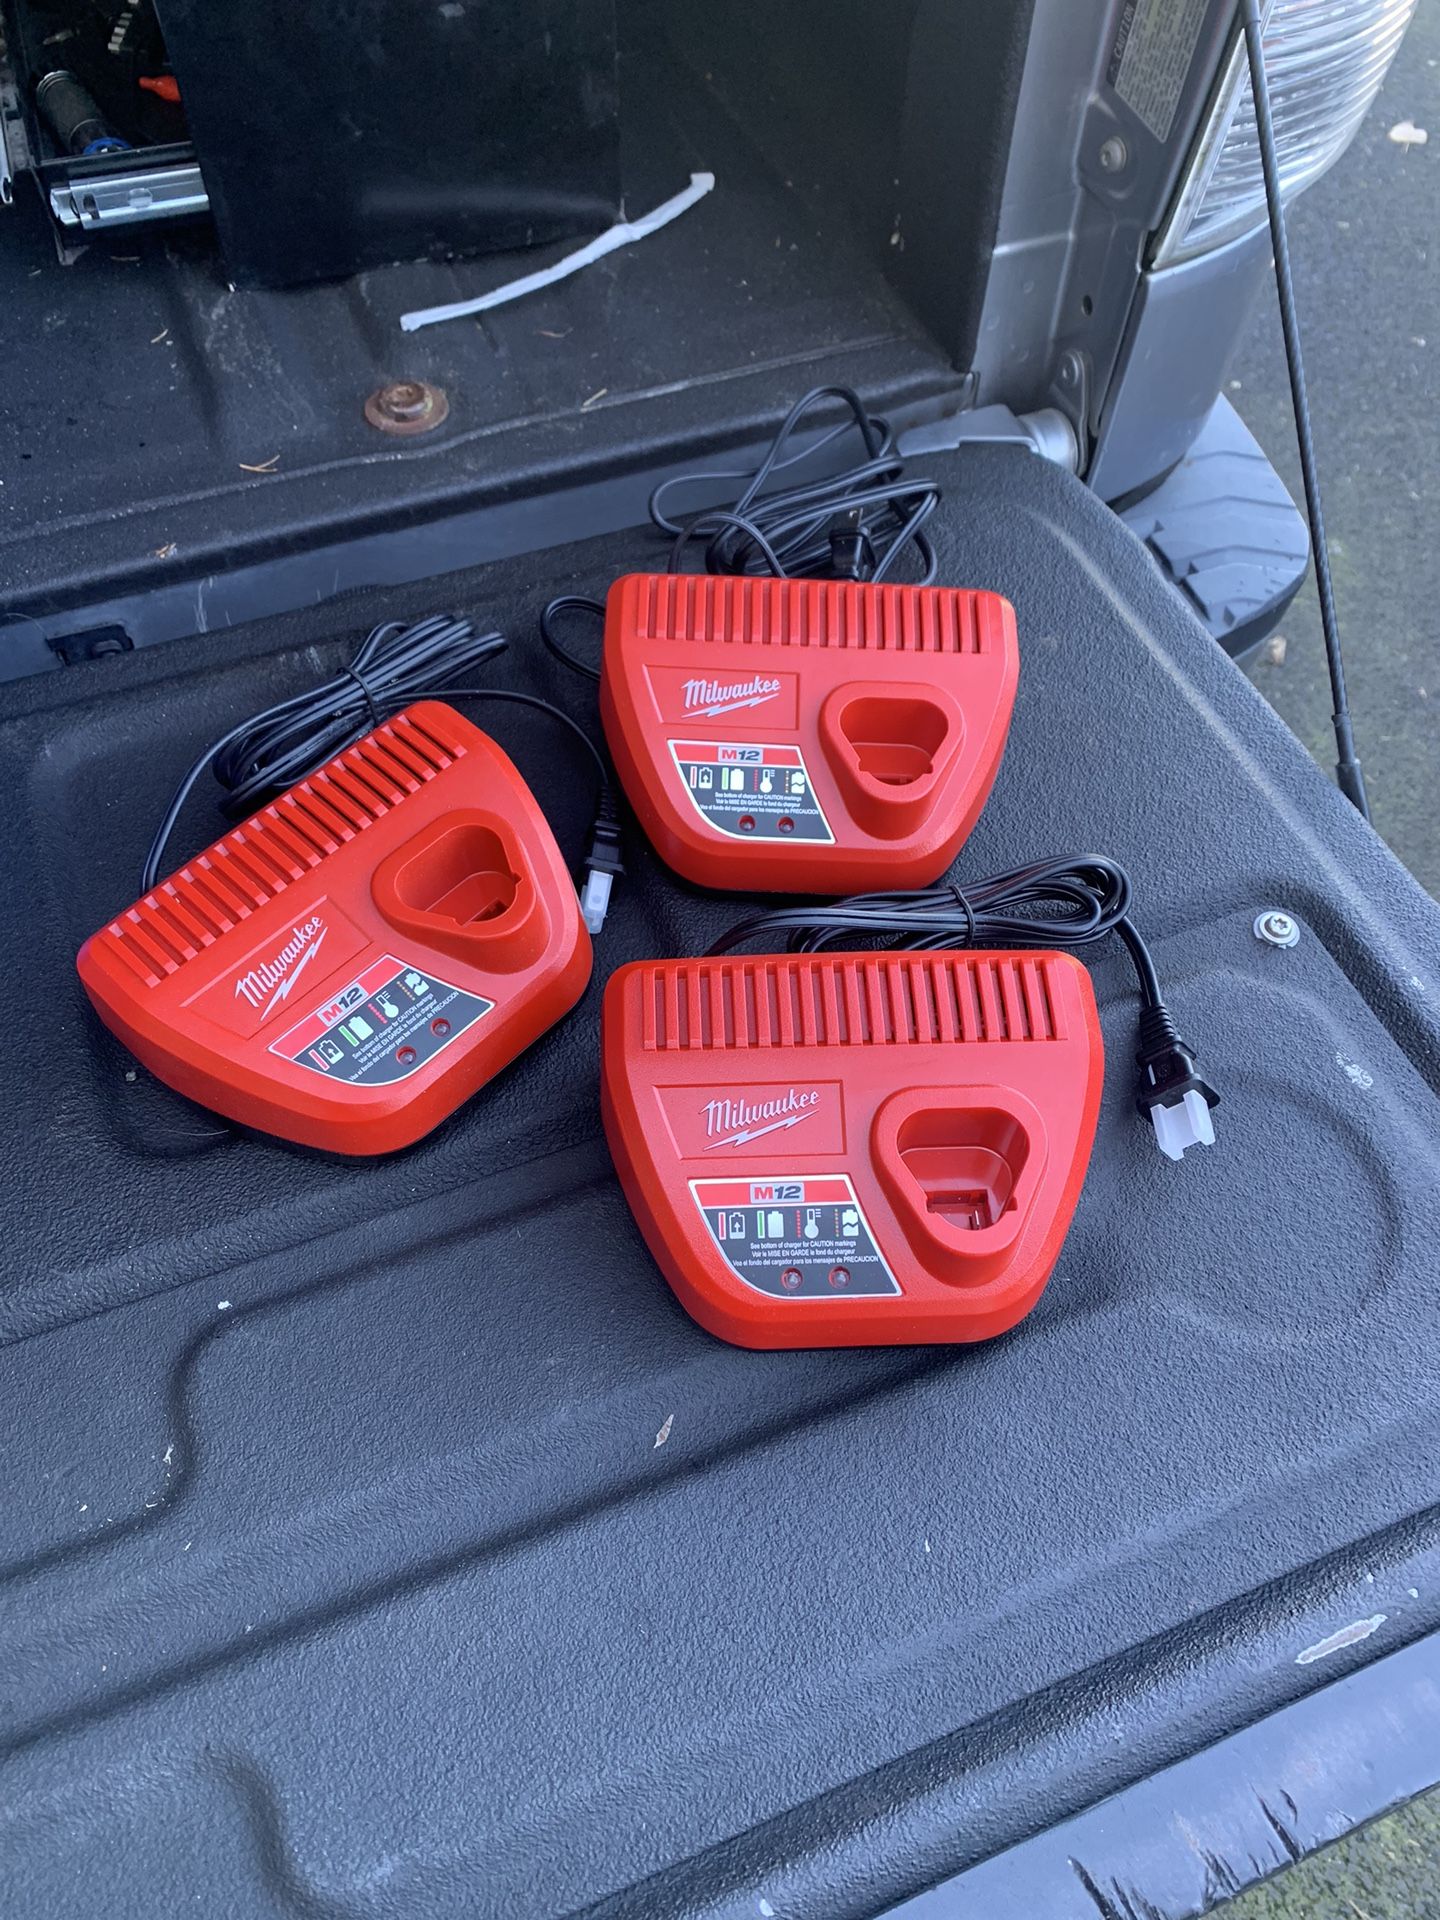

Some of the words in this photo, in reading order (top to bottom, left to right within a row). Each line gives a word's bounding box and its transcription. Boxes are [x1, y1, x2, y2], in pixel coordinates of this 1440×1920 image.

[1114, 3, 1134, 58] CAUTION
[681, 675, 781, 708] Milwaukee
[722, 748, 760, 761] M12
[234, 915, 323, 1008] Milwaukee
[322, 987, 364, 1023] M12
[699, 1089, 820, 1137] Milwaukee
[754, 1185, 802, 1200] M12
[834, 1240, 856, 1248] markings
[834, 1248, 856, 1256] chargeur
[771, 1258, 792, 1266] cargador
